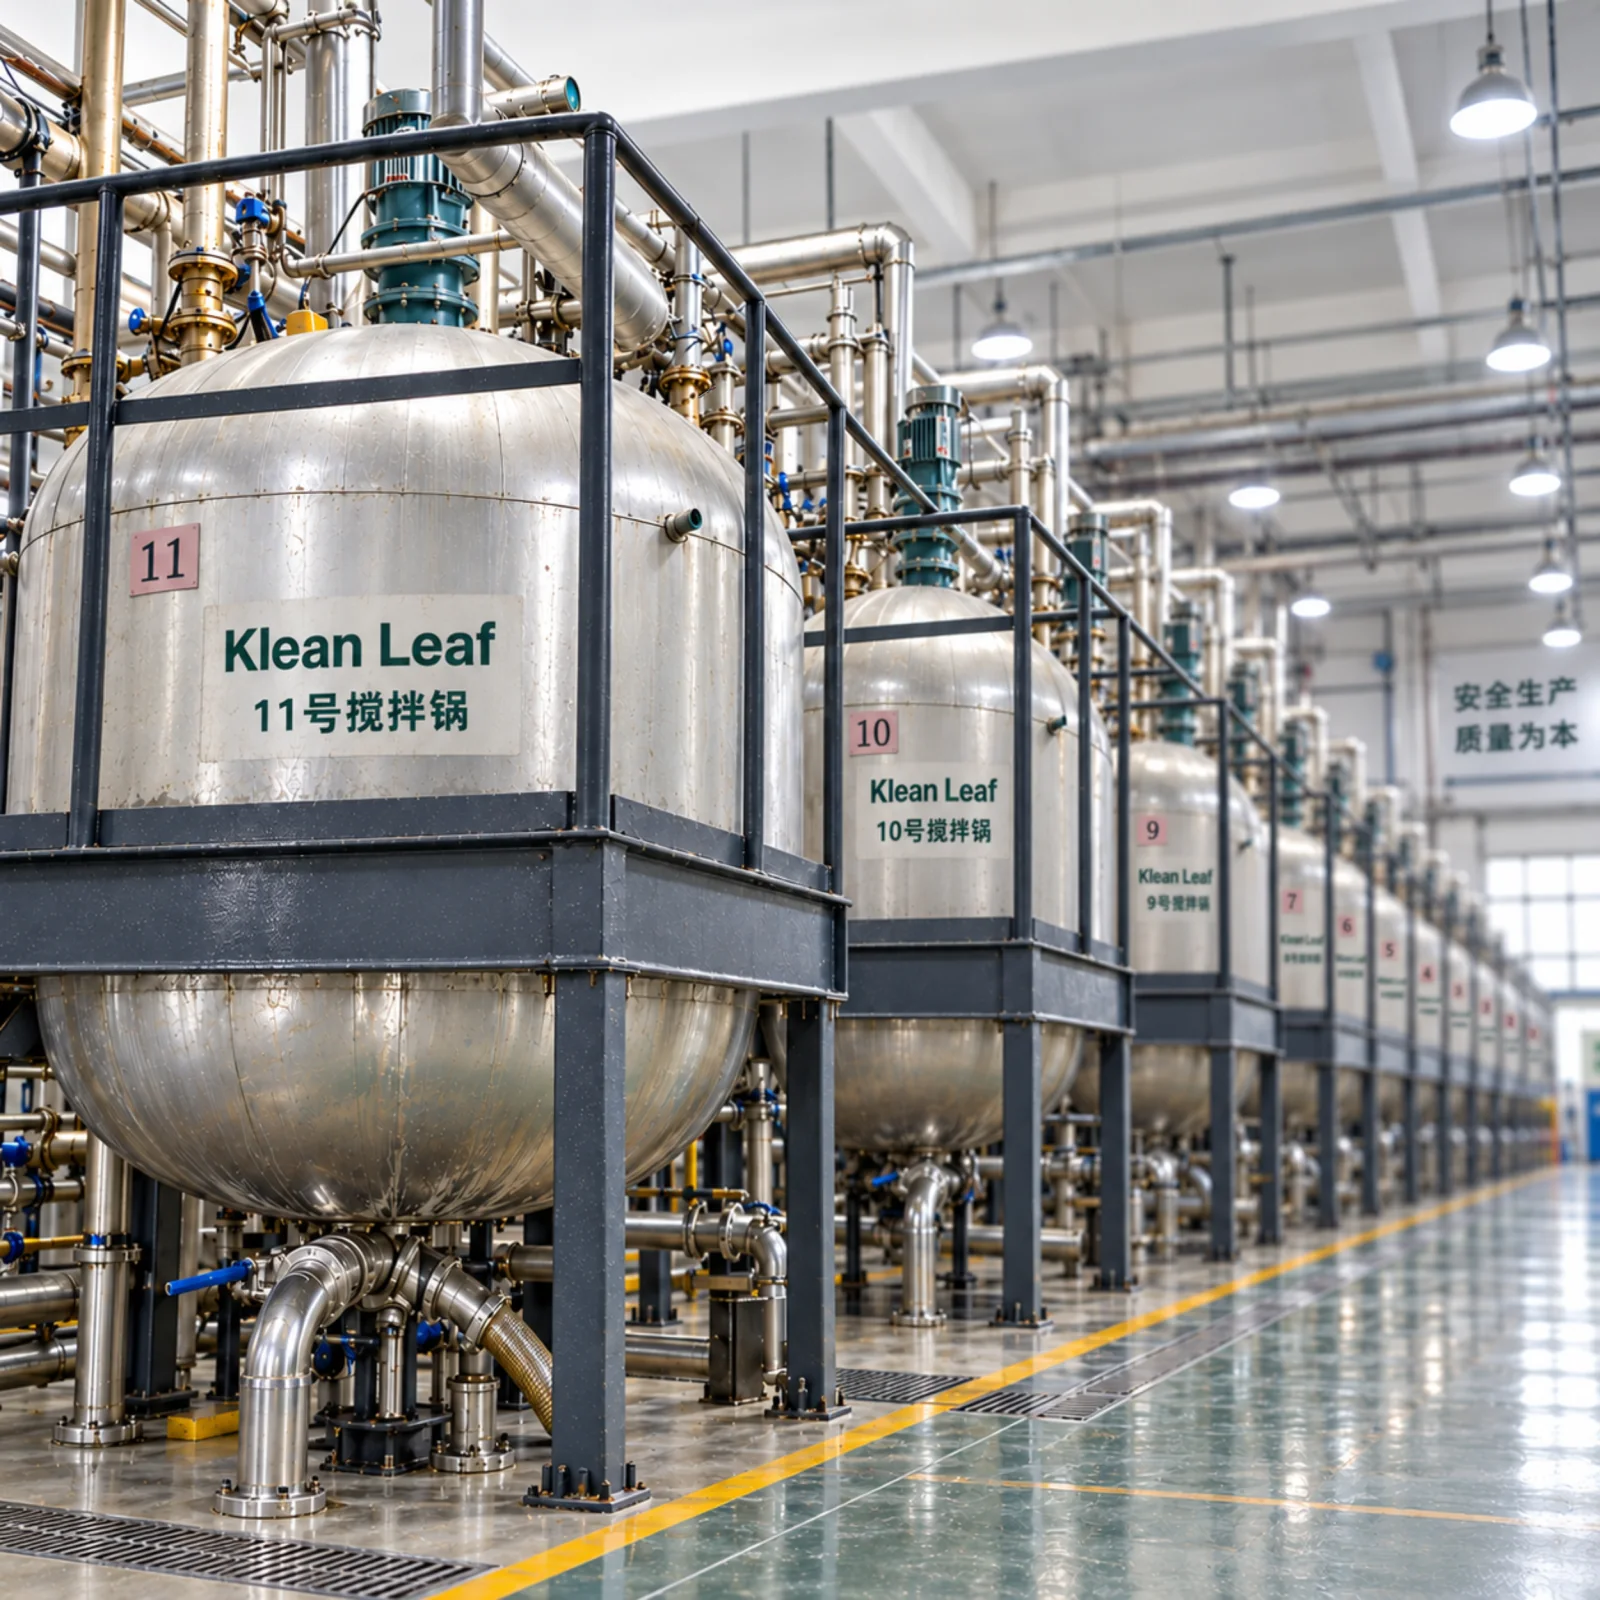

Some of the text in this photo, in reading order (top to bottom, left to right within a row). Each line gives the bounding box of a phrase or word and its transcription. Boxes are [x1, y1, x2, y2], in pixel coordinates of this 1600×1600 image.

[141, 537, 185, 582] 11
[225, 621, 496, 672] Klean Leaf
[1454, 676, 1577, 713] 安全生产
[254, 690, 468, 734] 11号搅拌锅
[857, 718, 891, 747] 10
[1455, 718, 1579, 754] 质量为本
[870, 777, 998, 804] Klean Leaf
[877, 818, 991, 843] 10号搅拌锅
[1146, 820, 1159, 840] 9
[1138, 868, 1213, 885] Klean Leaf
[1287, 892, 1297, 910] 7
[1342, 918, 1352, 933] 6
[1385, 942, 1395, 958] 5
